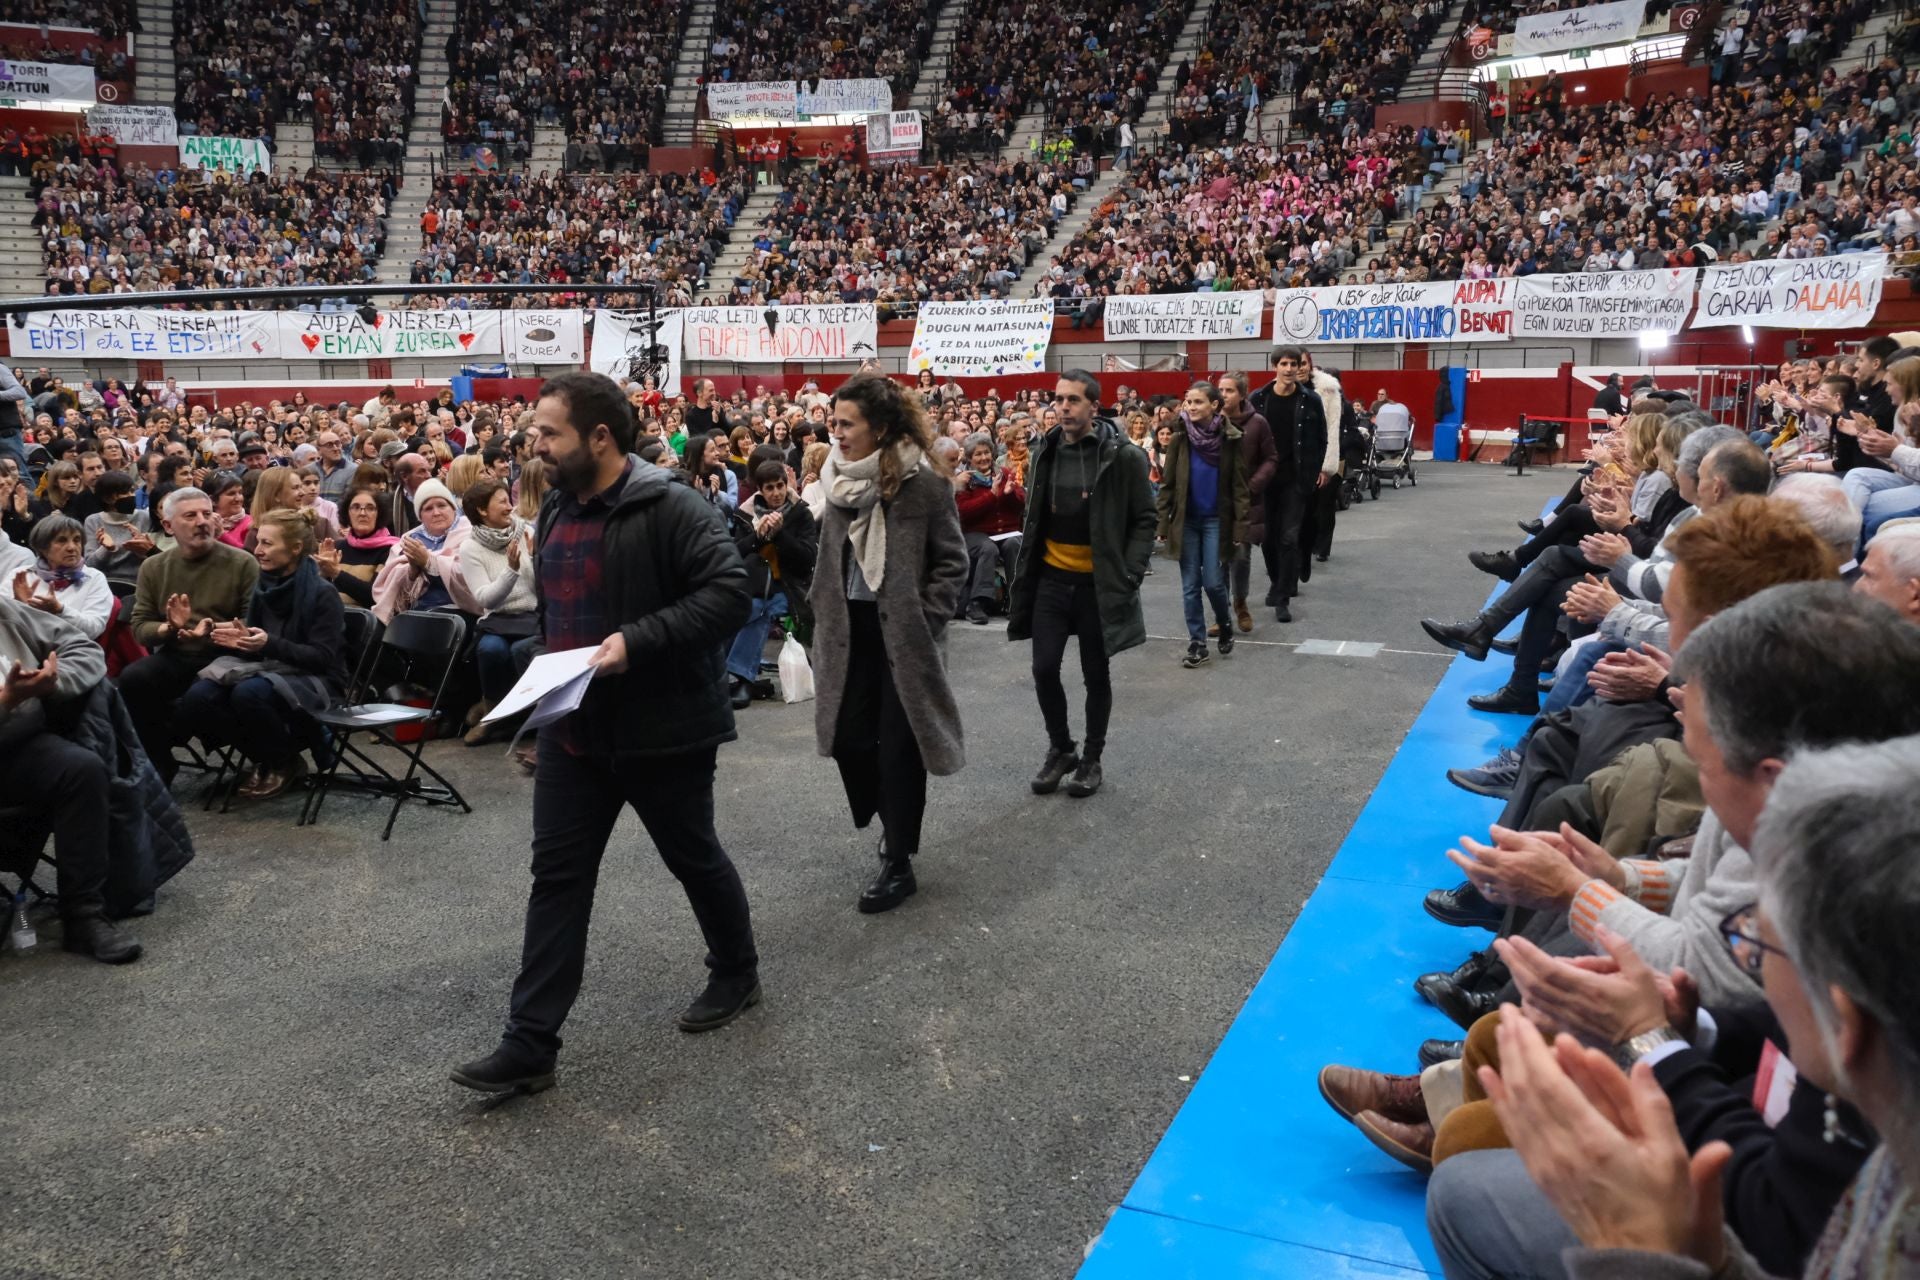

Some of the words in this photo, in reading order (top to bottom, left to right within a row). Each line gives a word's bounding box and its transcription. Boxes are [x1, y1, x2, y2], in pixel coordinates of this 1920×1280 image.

[1686, 13, 1693, 25] 3
[1477, 45, 1484, 55] 3
[895, 112, 915, 123] AUPA
[893, 125, 919, 136] NEREA
[1552, 272, 1612, 293] ESKERRIK
[1617, 274, 1656, 293] ASKO
[1714, 265, 1775, 289] DENOK
[1792, 260, 1860, 283] DAKIGU
[1453, 279, 1506, 304] AUPA!
[928, 305, 987, 316] ZUREKIKO
[1517, 295, 1574, 313] GIPUZKOA
[1578, 295, 1685, 313] TRANSFEMINISTAGOA
[1708, 289, 1774, 317] GARAIA
[48, 312, 140, 331] AURRERA
[306, 313, 366, 334] AUPA
[389, 311, 473, 332] NEREA!
[520, 314, 562, 326] NEREA
[687, 309, 719, 324] GAUR
[727, 309, 758, 324] LETU
[785, 307, 811, 324] DEK
[819, 303, 874, 325] TXEPETX?
[1523, 314, 1549, 331] EGIN
[1552, 316, 1594, 332] DUZUEN
[926, 322, 971, 333] DUGUN
[974, 320, 1044, 332] MAITASUNA
[1108, 318, 1140, 335] ILUNBE
[1145, 317, 1195, 334] TOREATZIE
[1202, 318, 1232, 335] FALTA!
[96, 331, 124, 350] eta
[132, 332, 158, 351] EZ
[324, 333, 382, 354] EMAN
[395, 332, 456, 353] ZUREA
[521, 344, 562, 355] ZUREA
[698, 327, 748, 357] AUPA
[940, 340, 952, 348] EZ
[956, 340, 970, 348] DA
[974, 338, 1025, 348] ILLUNBEN
